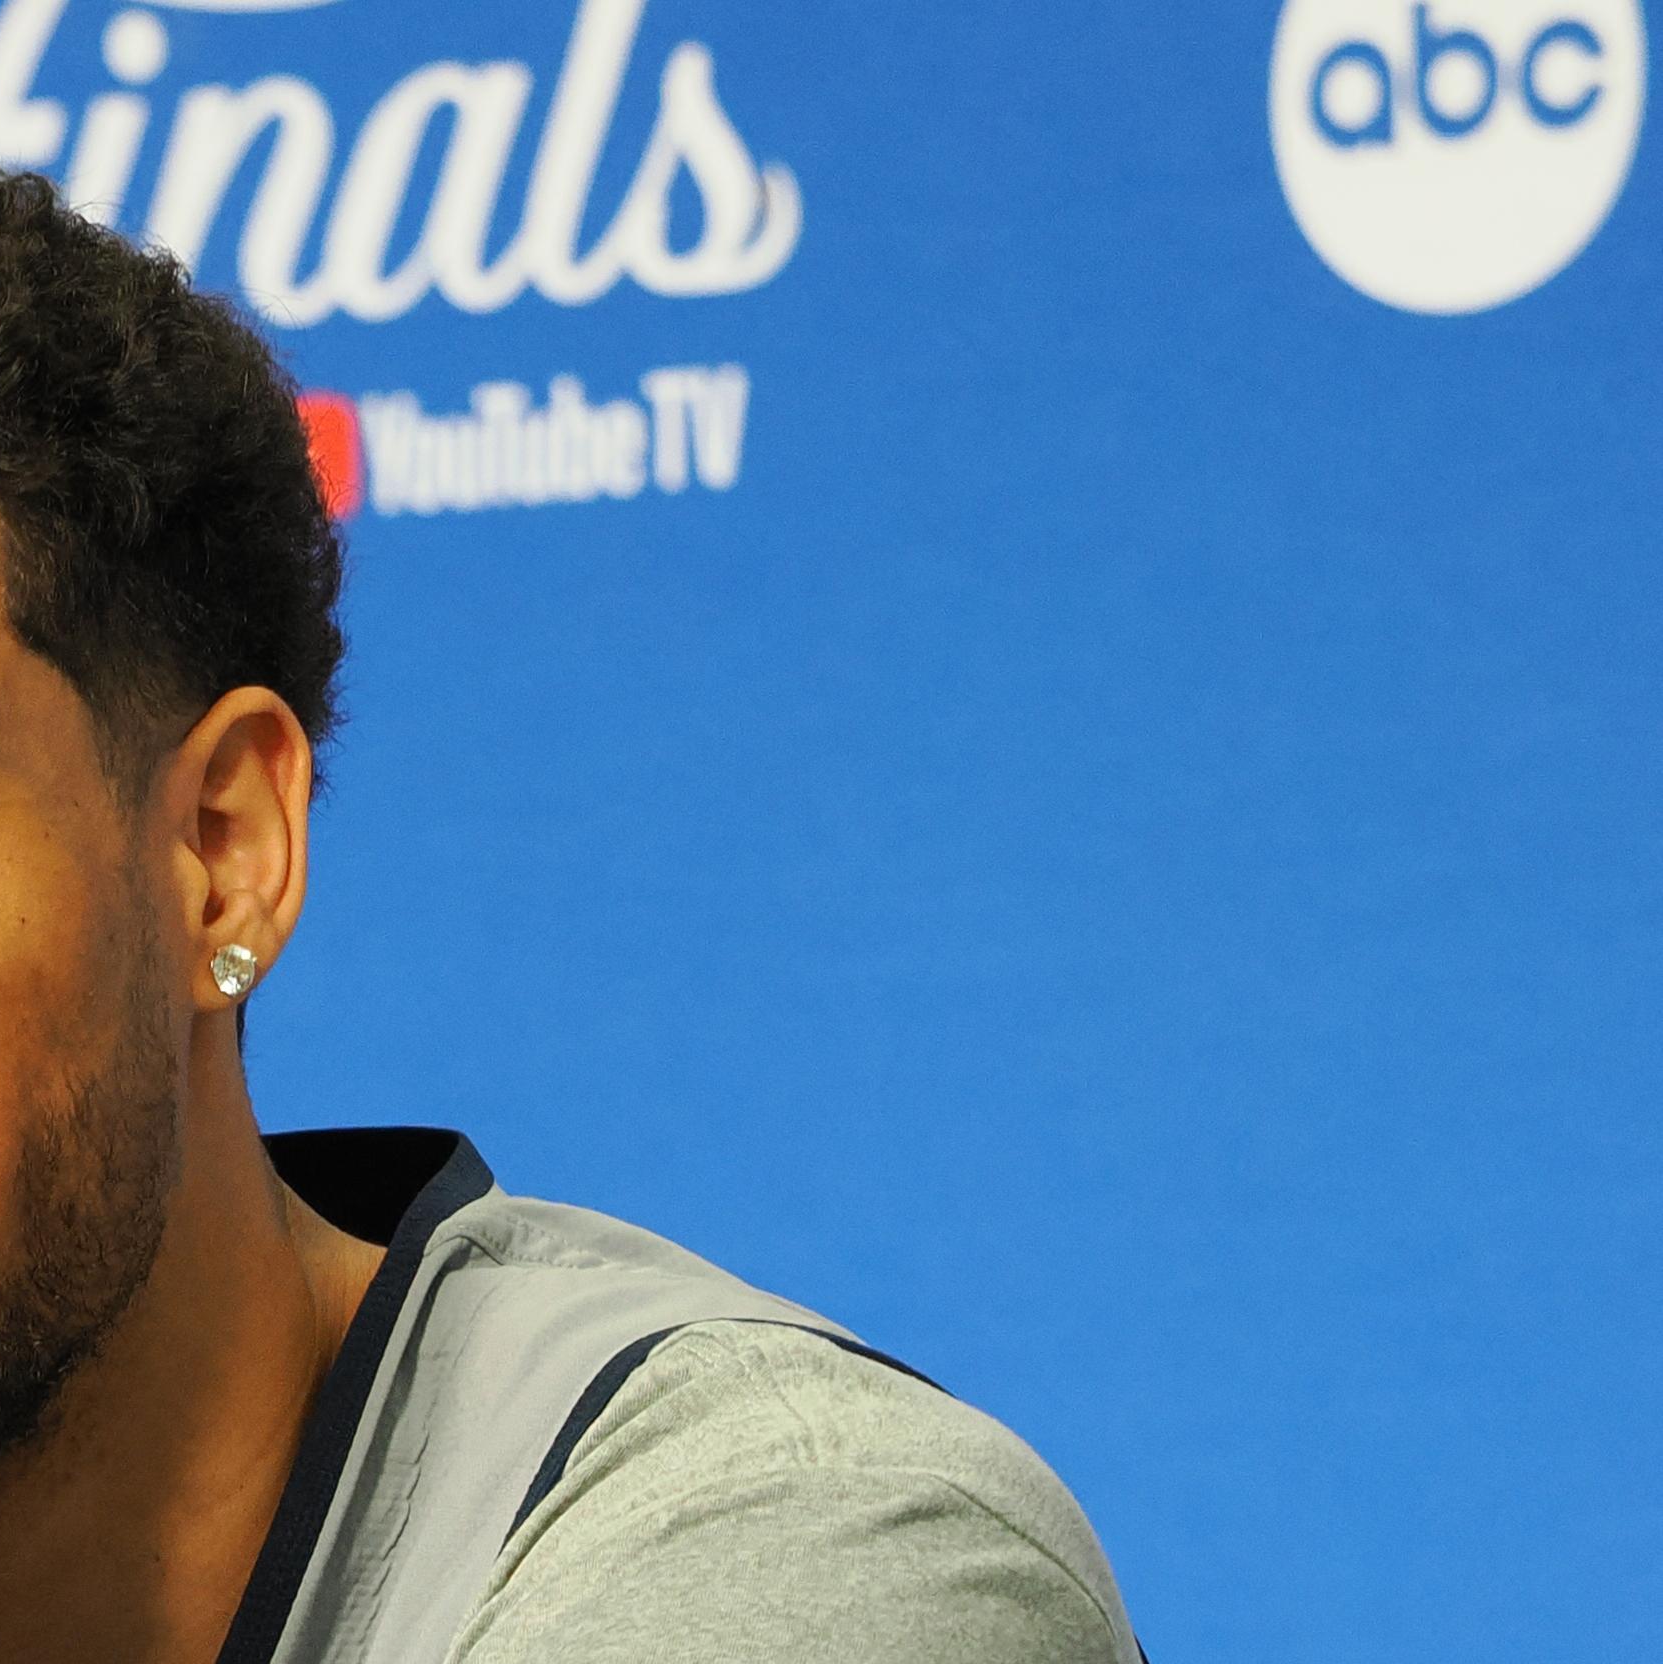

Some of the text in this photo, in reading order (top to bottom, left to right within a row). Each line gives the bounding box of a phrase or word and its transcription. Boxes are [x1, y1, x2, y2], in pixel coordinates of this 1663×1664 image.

[1309, 0, 1603, 148] abc
[359, 361, 752, 518] YouTube TV
